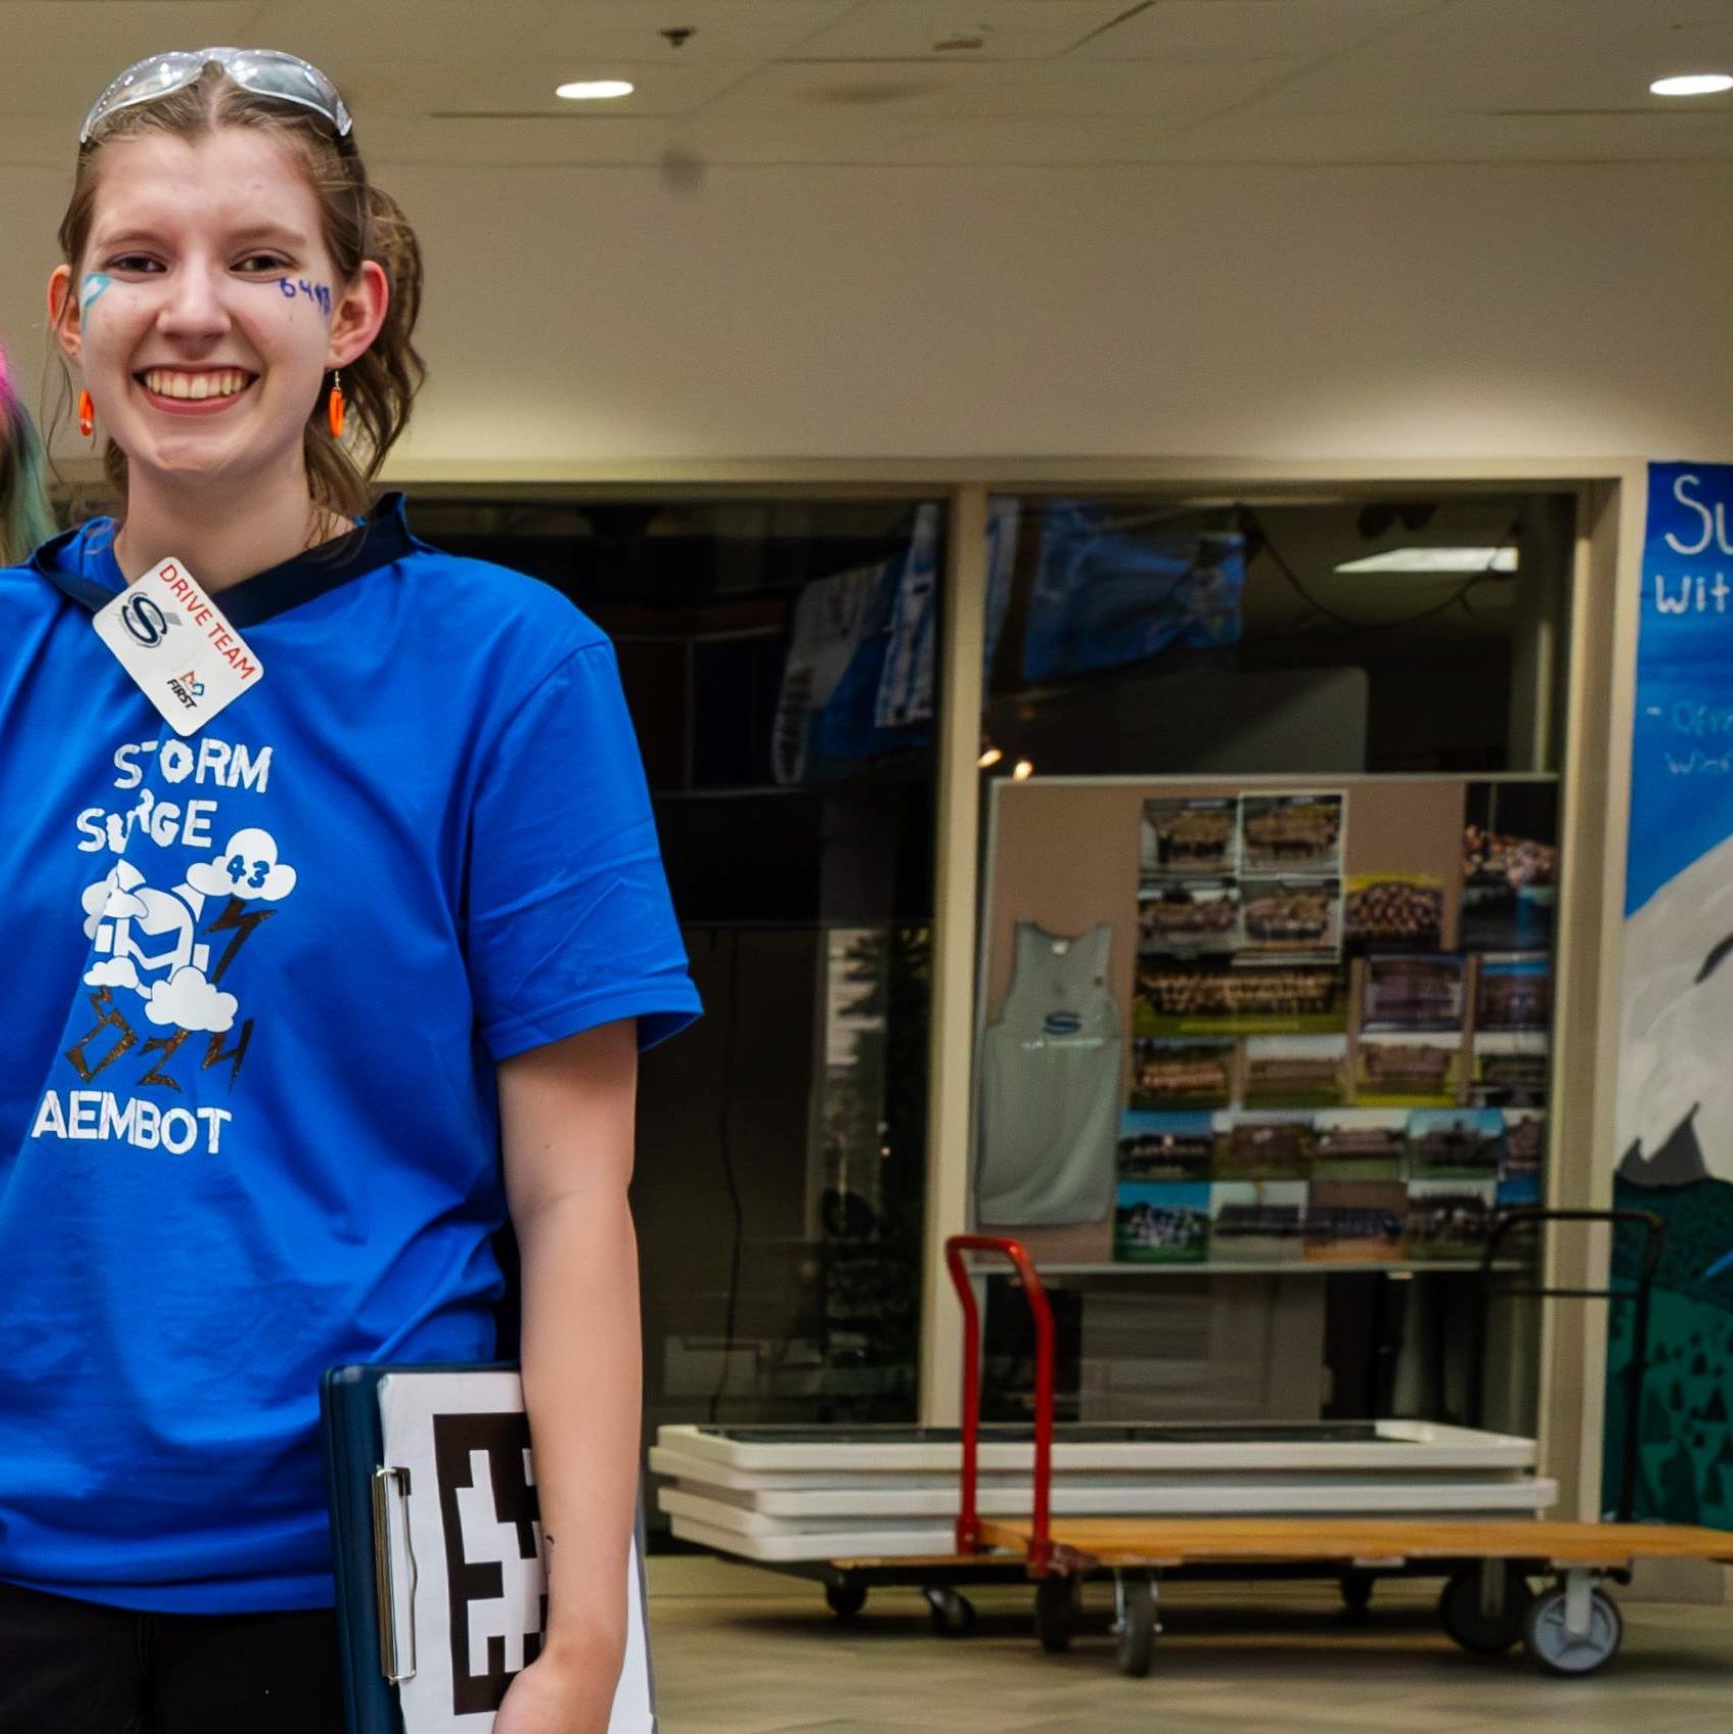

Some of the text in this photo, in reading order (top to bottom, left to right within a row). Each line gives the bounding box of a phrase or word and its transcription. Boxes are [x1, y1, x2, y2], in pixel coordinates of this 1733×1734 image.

[159, 564, 256, 680] DRIVE TEAM
[167, 678, 197, 709] FIRST
[226, 854, 270, 888] 43
[31, 1089, 232, 1155] AEMBOT
